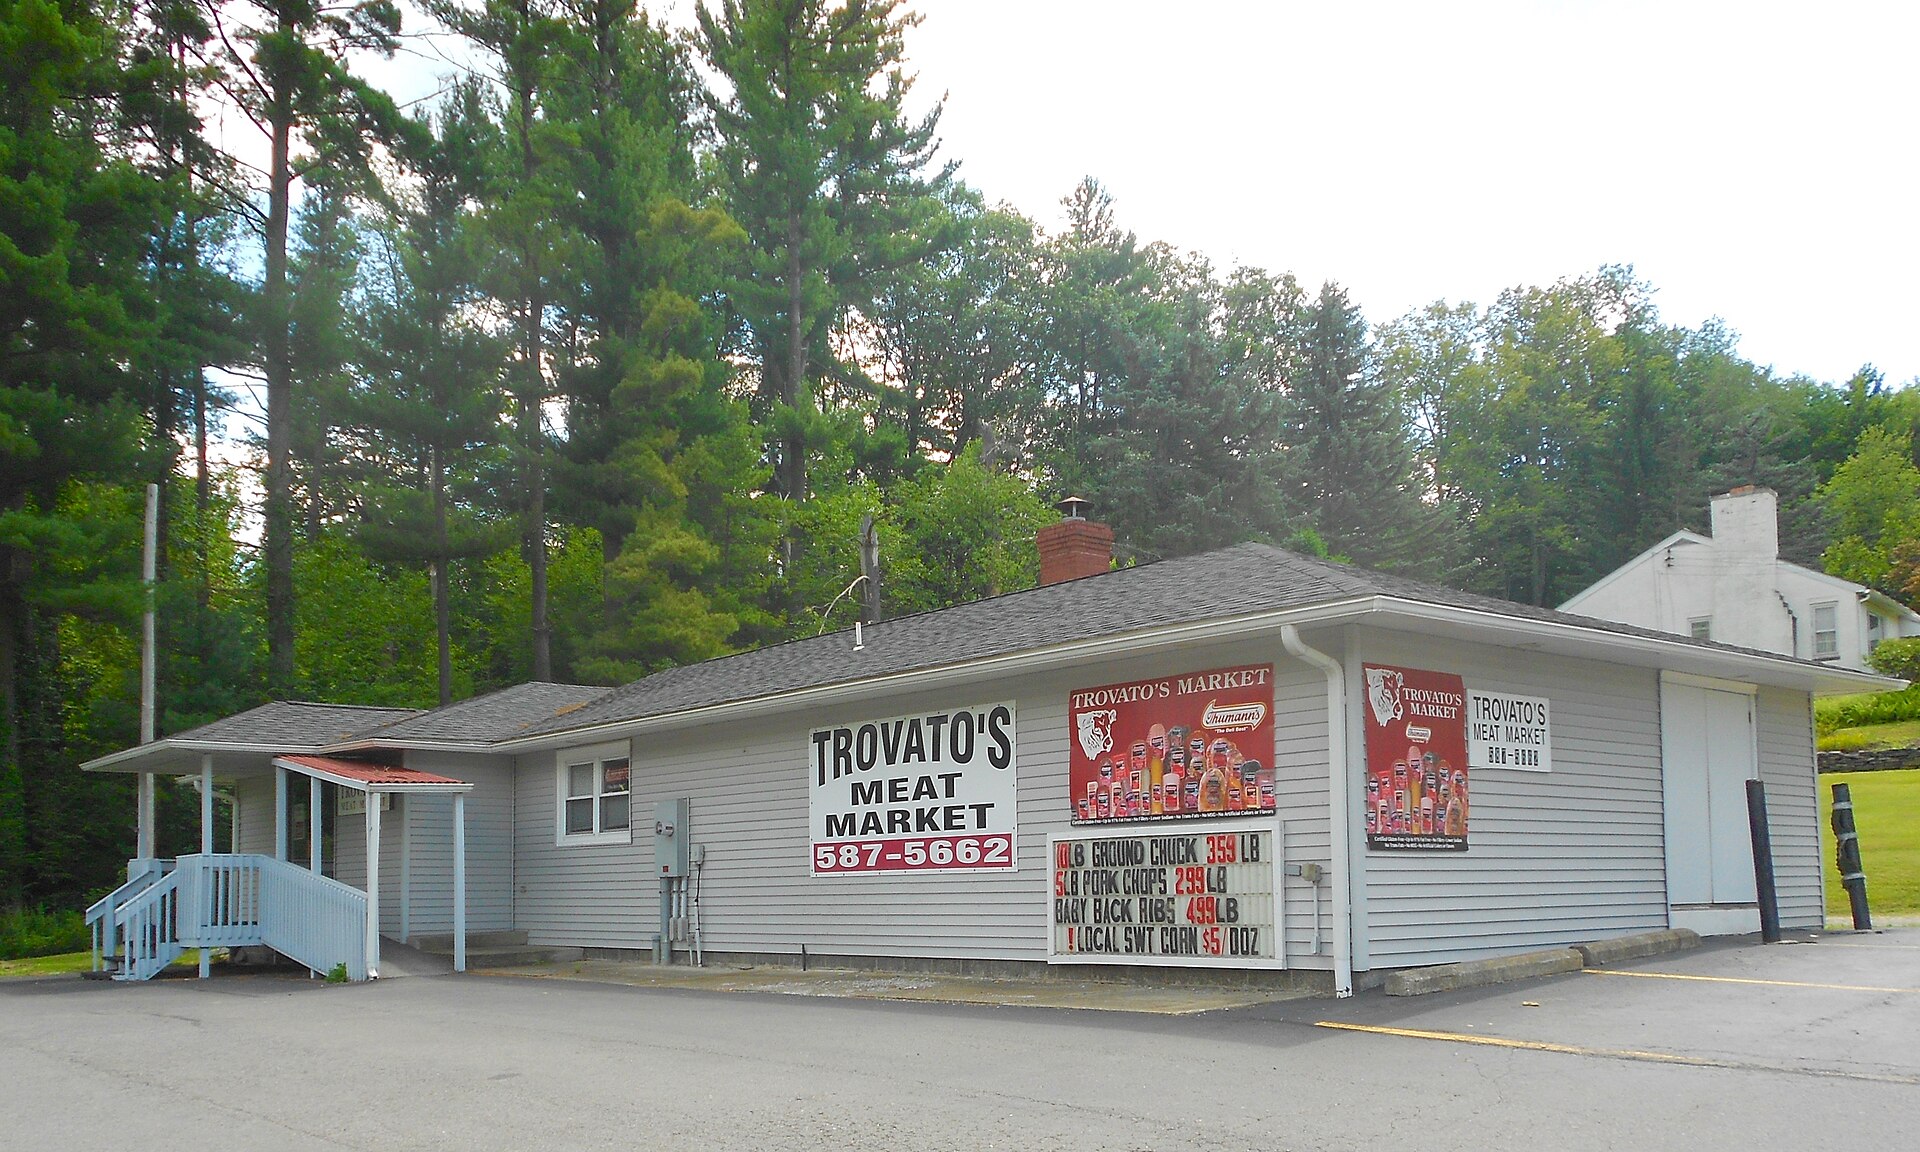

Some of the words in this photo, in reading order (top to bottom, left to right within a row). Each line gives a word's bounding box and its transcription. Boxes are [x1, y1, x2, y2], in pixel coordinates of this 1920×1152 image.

[1073, 682, 1169, 709] TROVATO'S
[1177, 668, 1269, 696] MARKET
[1403, 687, 1462, 706] TROVATO'S
[1410, 702, 1457, 719] MARKET
[1473, 696, 1546, 726] TROVATO'S
[813, 706, 1011, 787] TROVATO'S
[1473, 723, 1500, 742] MEAT
[1505, 726, 1546, 745] MARKET
[851, 772, 962, 806] MEAT
[825, 802, 995, 837] MARKET
[816, 837, 1010, 870] 587-5662
[1092, 840, 1145, 867] GROUND
[1150, 838, 1198, 864] CHUCK
[1206, 835, 1236, 863] 359
[1241, 834, 1260, 862] LB
[1056, 870, 1079, 896] 5LB
[1083, 869, 1119, 895] PORK
[1122, 868, 1167, 895] CHOPS
[1055, 899, 1086, 924] BABY
[1093, 898, 1132, 923] BACK
[1139, 897, 1176, 923] RIBS
[1124, 926, 1154, 953] SWT
[1161, 926, 1198, 954] CORN
